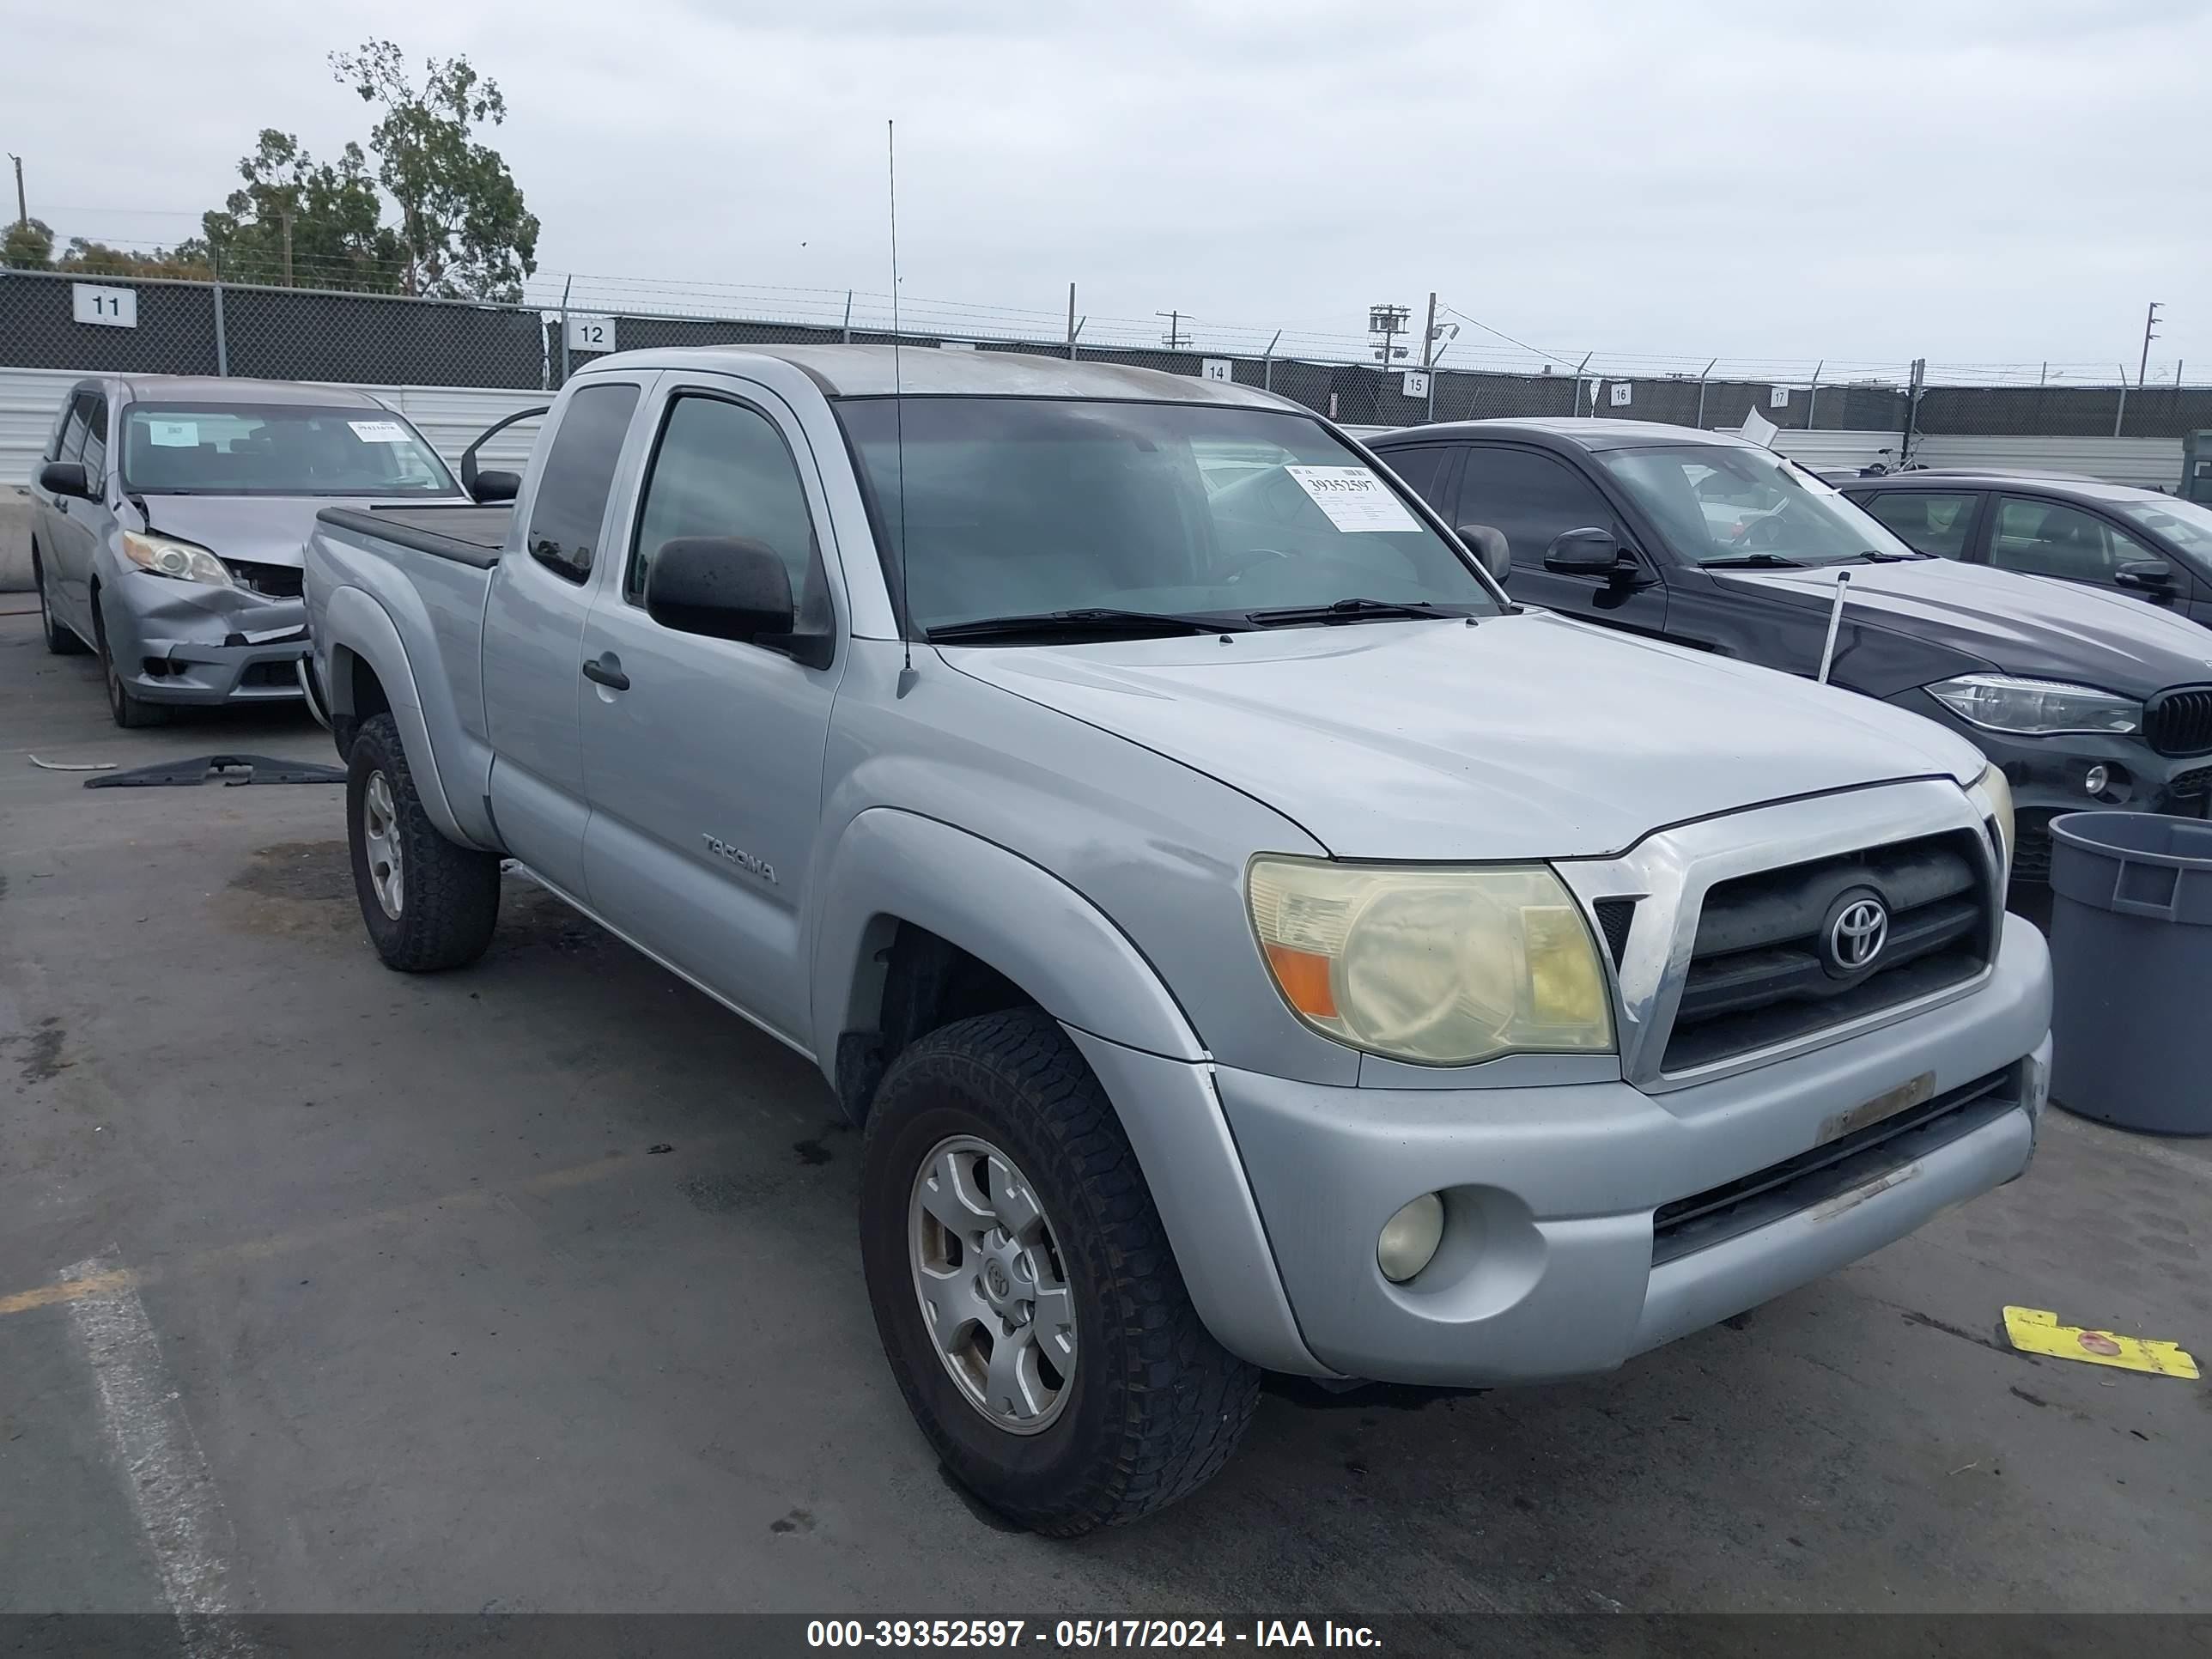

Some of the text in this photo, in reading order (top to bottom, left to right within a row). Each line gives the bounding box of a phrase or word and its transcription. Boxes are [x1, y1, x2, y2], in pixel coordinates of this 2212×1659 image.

[92, 295, 118, 317] 11
[580, 325, 604, 343] 12
[1210, 366, 1224, 380] 14
[1410, 378, 1422, 392] 15
[1616, 389, 1626, 400] 16
[1776, 392, 1784, 404] 17
[1307, 479, 1377, 492] 39352597
[702, 832, 779, 886] TACOMA
